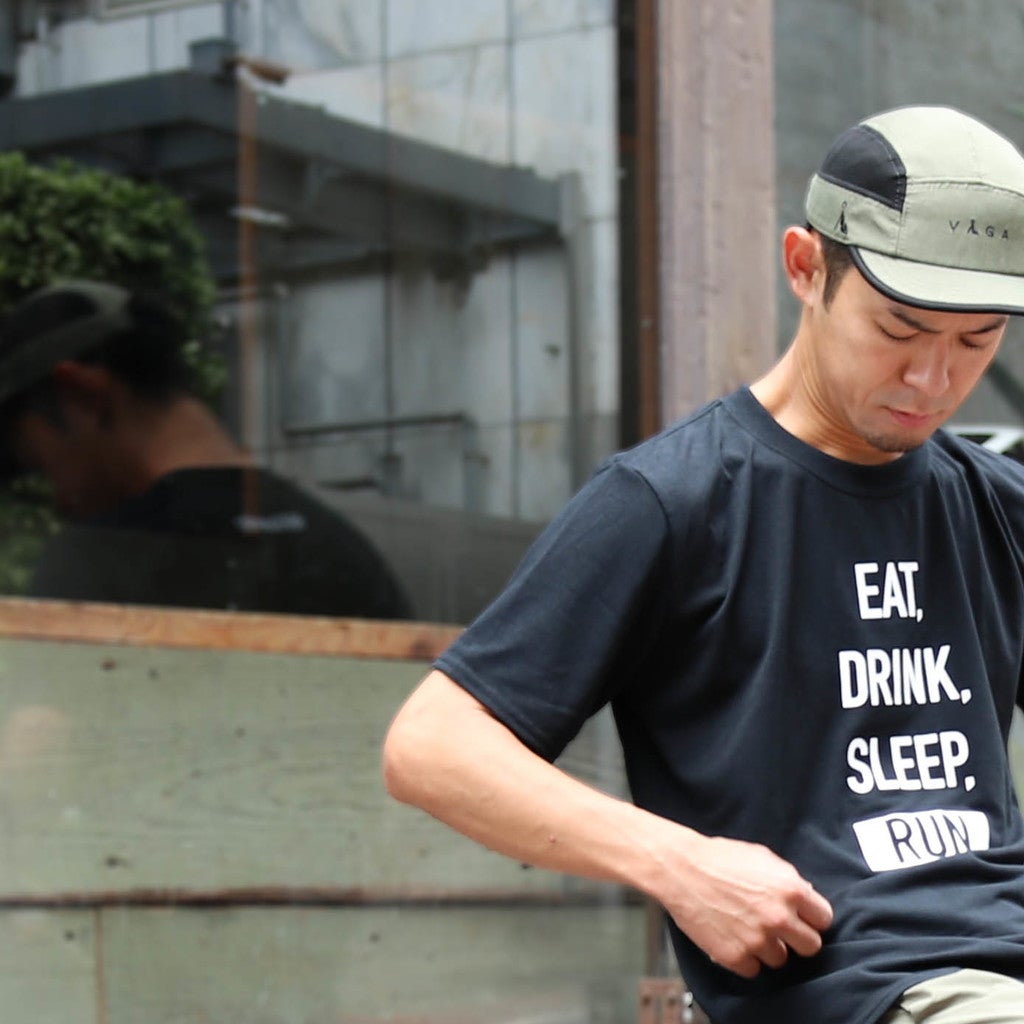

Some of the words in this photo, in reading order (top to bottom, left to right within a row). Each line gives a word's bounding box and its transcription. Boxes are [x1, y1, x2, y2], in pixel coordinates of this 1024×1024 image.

[854, 561, 924, 623] EAT,
[838, 644, 972, 709] DRINK,
[846, 730, 976, 795] SLEEP,
[885, 813, 971, 863] RUN
